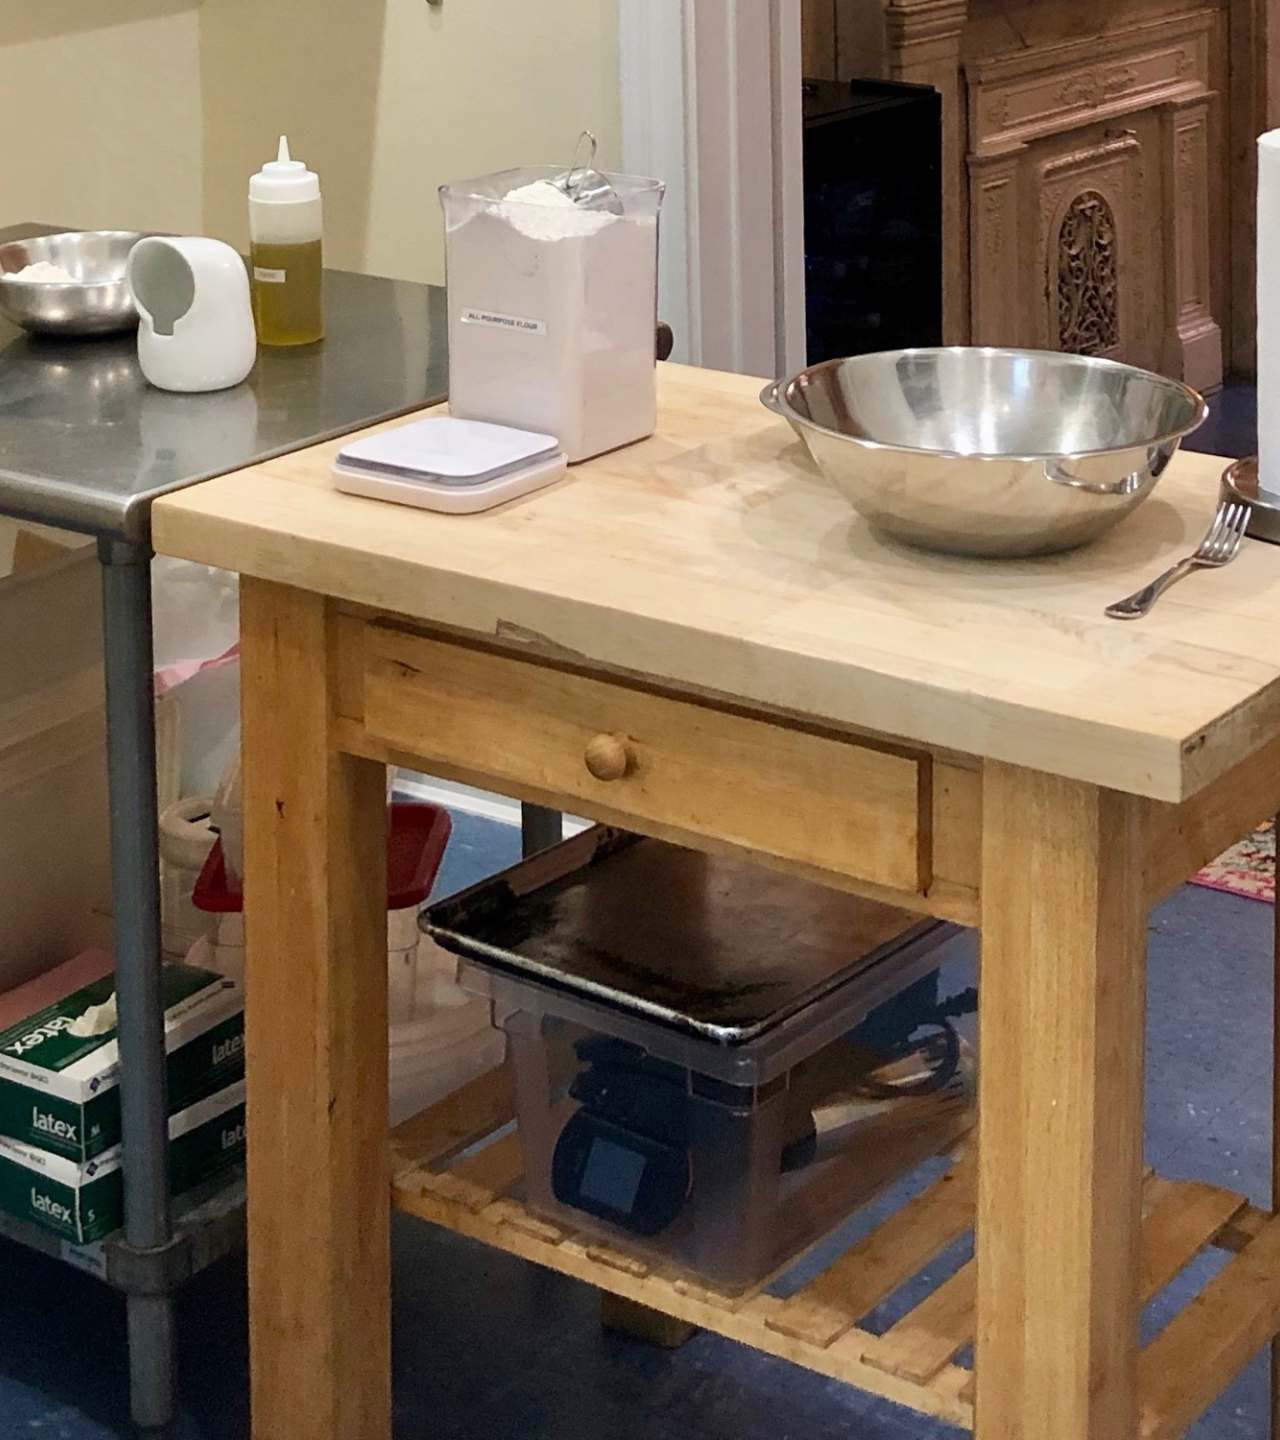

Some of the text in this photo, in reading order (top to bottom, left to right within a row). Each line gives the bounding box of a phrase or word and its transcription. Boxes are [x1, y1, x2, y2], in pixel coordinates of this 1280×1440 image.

[211, 1034, 245, 1065] late
[32, 1106, 78, 1141] latex
[222, 1123, 246, 1150] lat
[30, 1186, 73, 1225] latex
